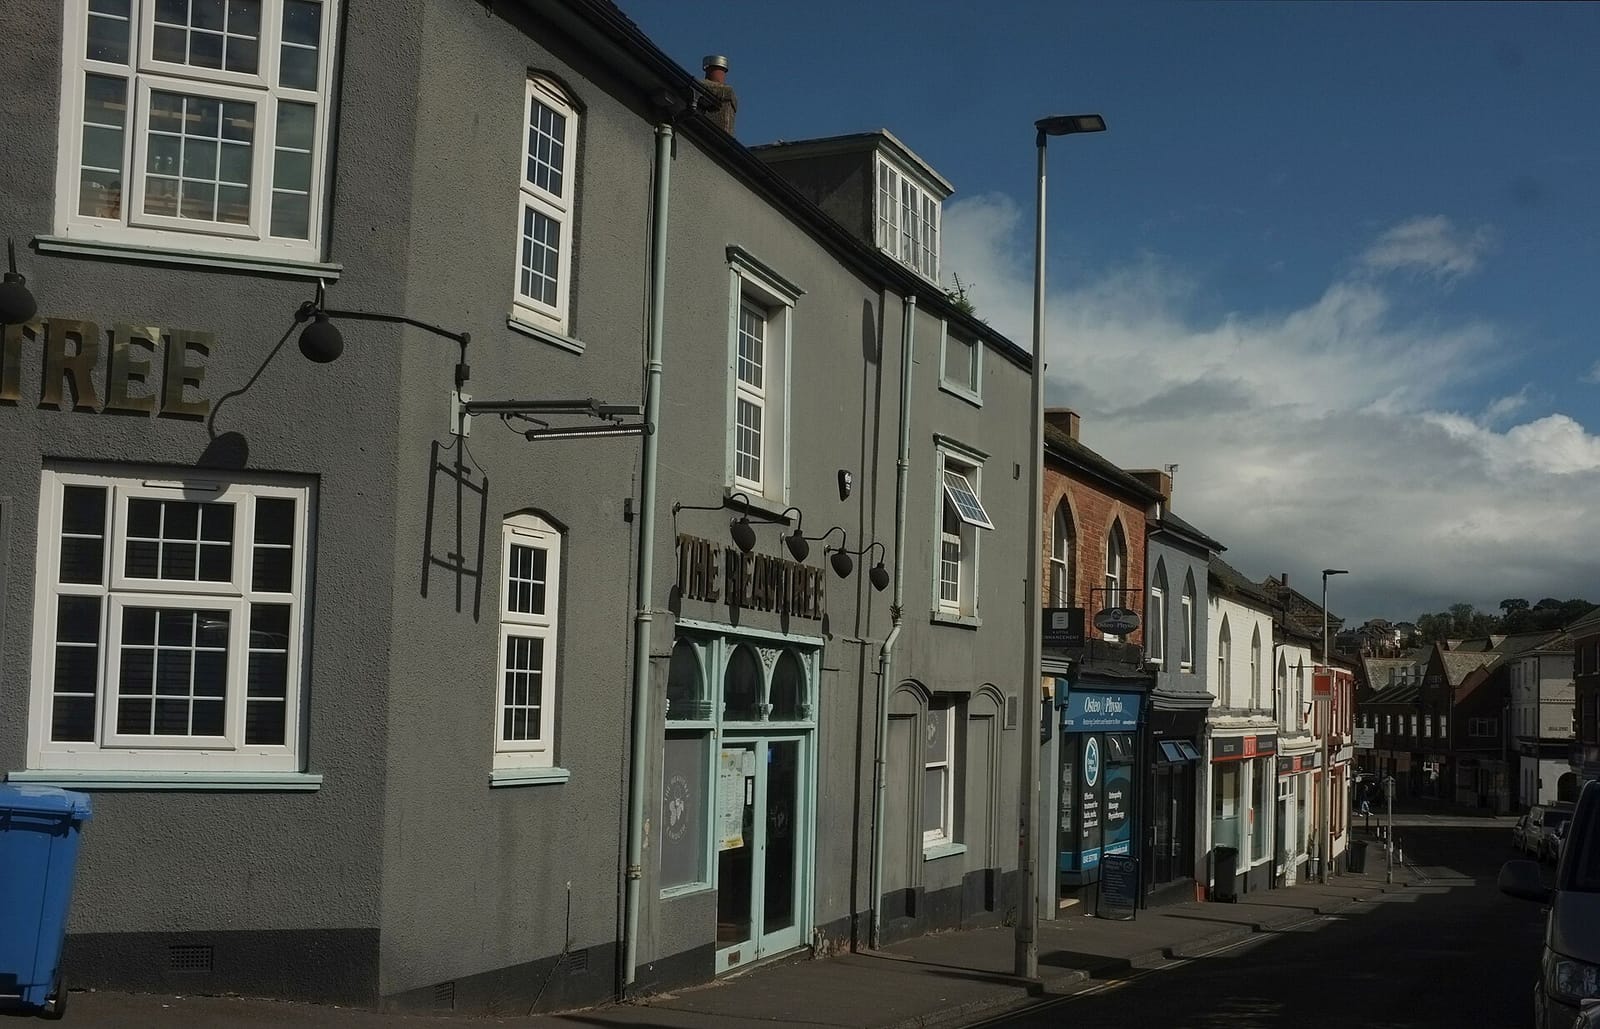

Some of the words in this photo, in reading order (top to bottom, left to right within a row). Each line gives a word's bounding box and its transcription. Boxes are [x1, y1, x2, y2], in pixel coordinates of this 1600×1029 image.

[677, 533, 720, 602] THE
[1084, 696, 1100, 713] Osteo
[1105, 696, 1123, 716] Physio
